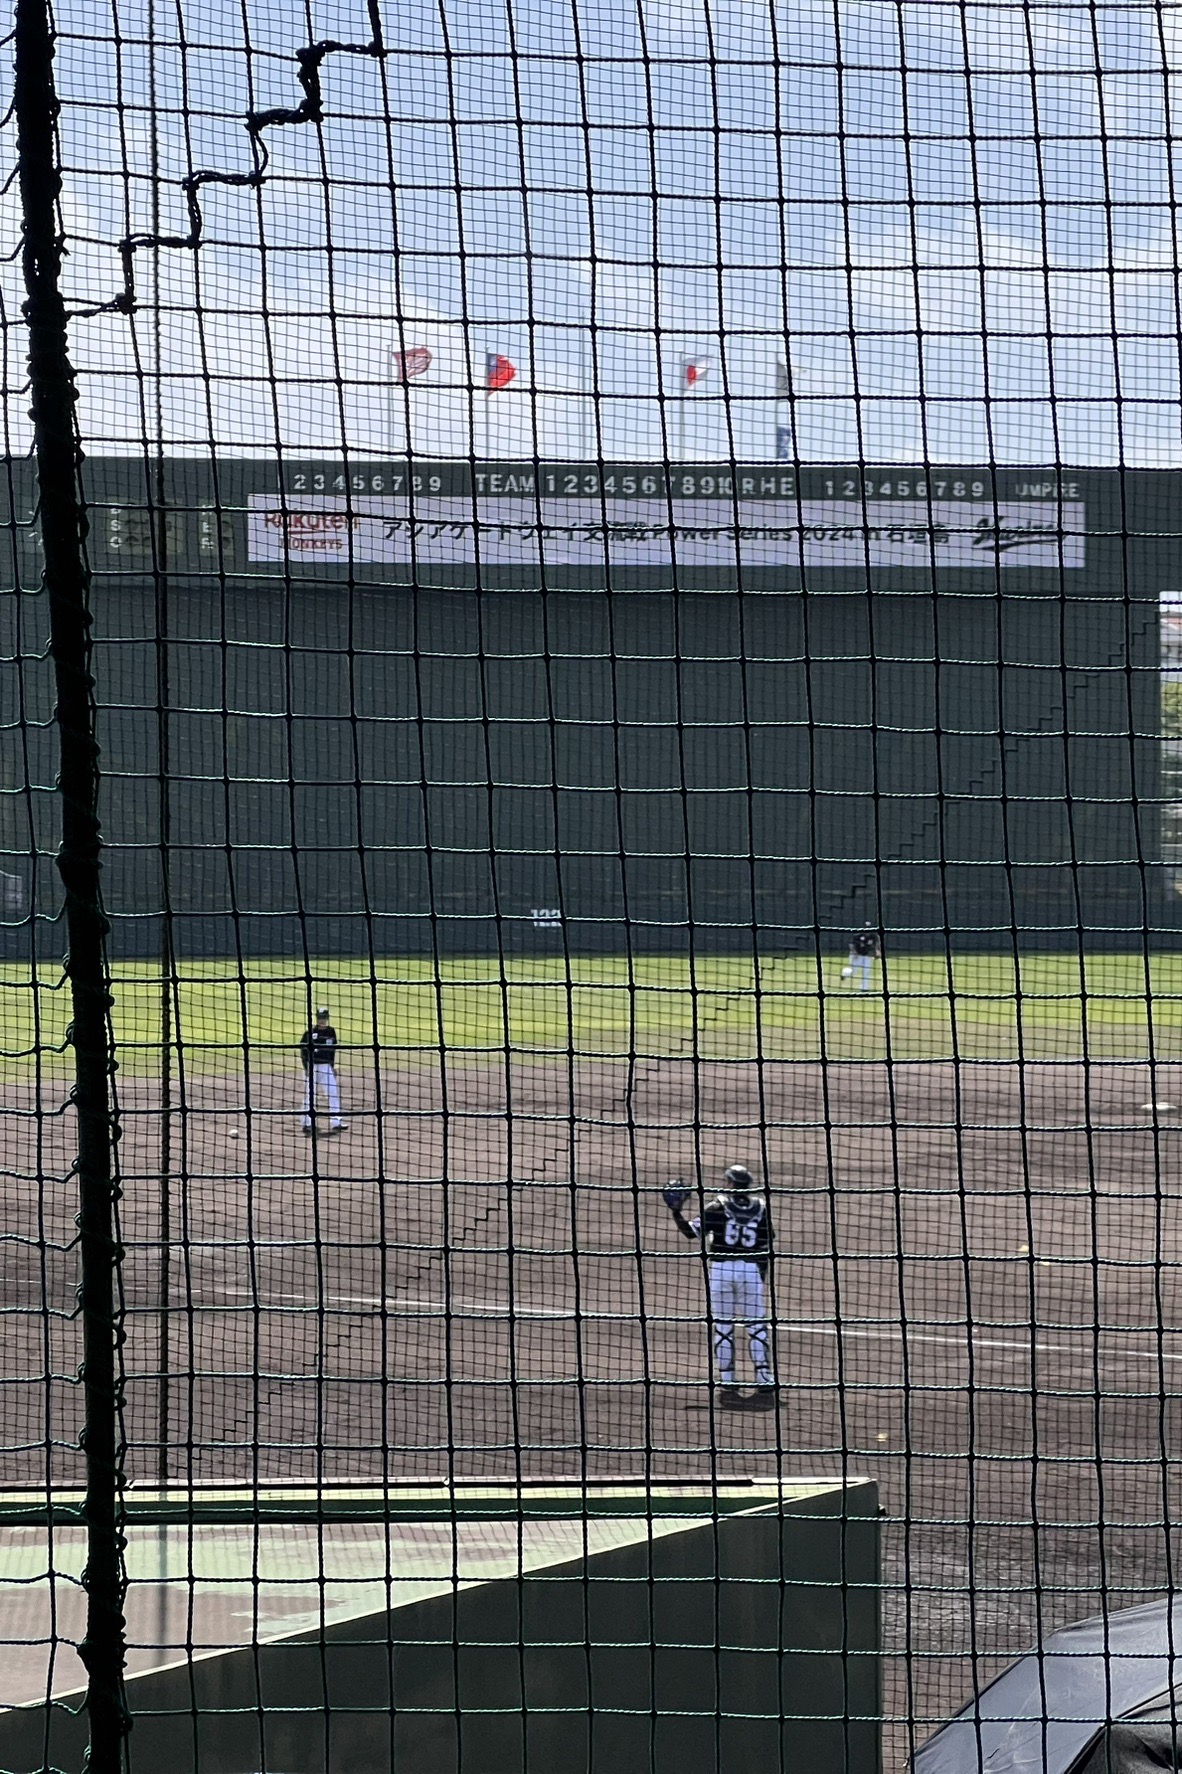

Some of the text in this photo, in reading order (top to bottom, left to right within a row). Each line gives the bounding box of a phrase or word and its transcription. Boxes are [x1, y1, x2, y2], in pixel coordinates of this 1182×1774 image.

[475, 474, 535, 493] TEAM
[802, 523, 855, 542] 2024
[725, 1219, 758, 1247] 65
